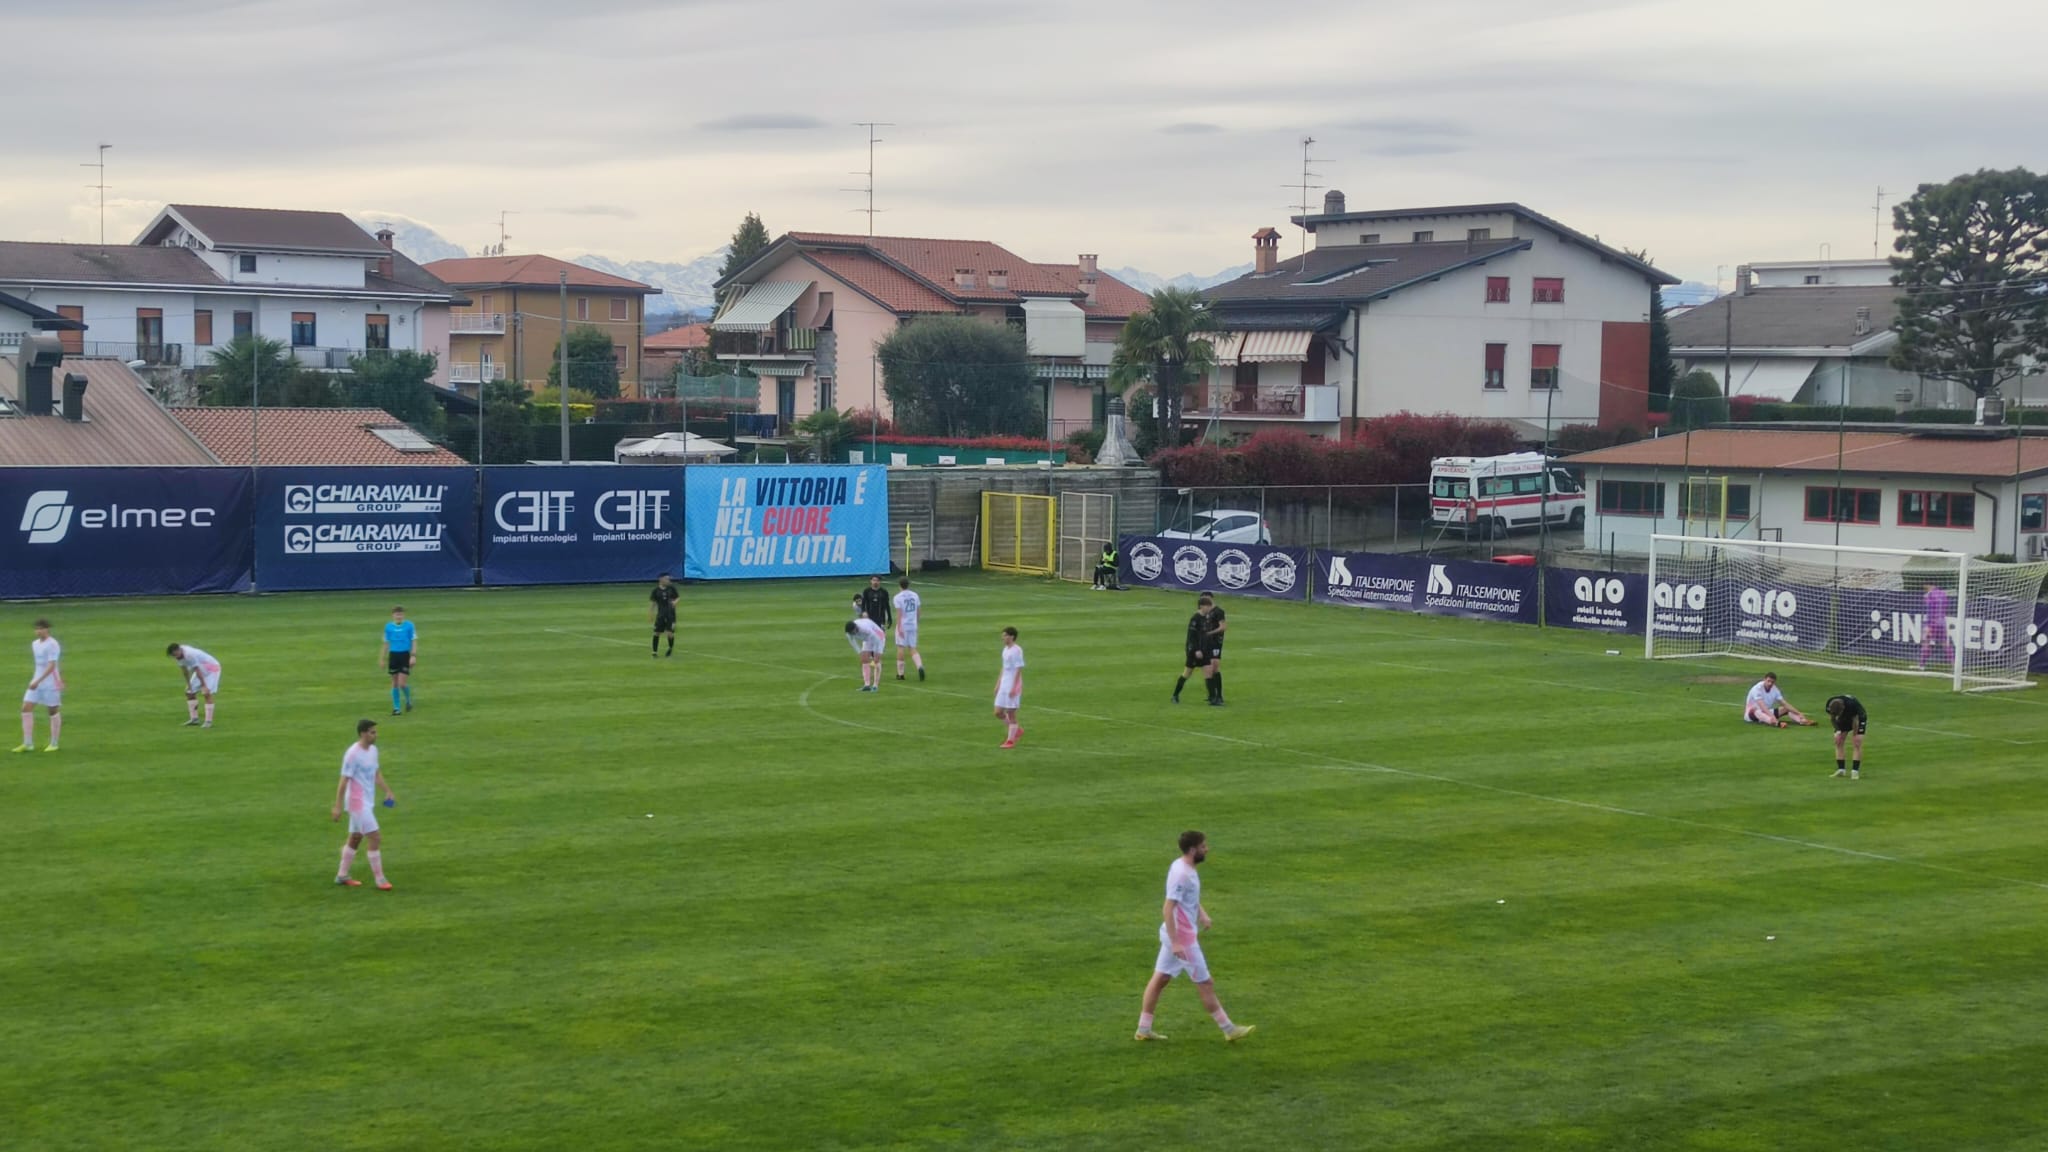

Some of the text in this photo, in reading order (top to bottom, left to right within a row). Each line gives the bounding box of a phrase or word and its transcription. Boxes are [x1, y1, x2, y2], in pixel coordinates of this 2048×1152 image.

[315, 485, 443, 502] CHIARAVALLI
[719, 470, 868, 507] LA VITTORIA É
[80, 503, 216, 528] elmec
[356, 504, 402, 512] GROUP
[714, 507, 832, 537] NEL CUORE
[315, 523, 442, 541] CHIARAVALLI
[493, 533, 578, 544] impianti tecnologici
[593, 531, 672, 543] impianti tecnologici
[356, 543, 401, 551] GROUP
[709, 535, 852, 567] DI CHI LOTTA.
[1355, 576, 1415, 592] ITALSEMPIONE
[1456, 584, 1521, 602] ITALSEMPIONE
[1574, 576, 1625, 604] aro
[1328, 585, 1412, 603] Spedizioni internazionali
[1654, 582, 1707, 610] aro
[1740, 588, 1797, 617] aro
[904, 598, 916, 612] 26
[1425, 595, 1520, 613] Spedizioni internazionali
